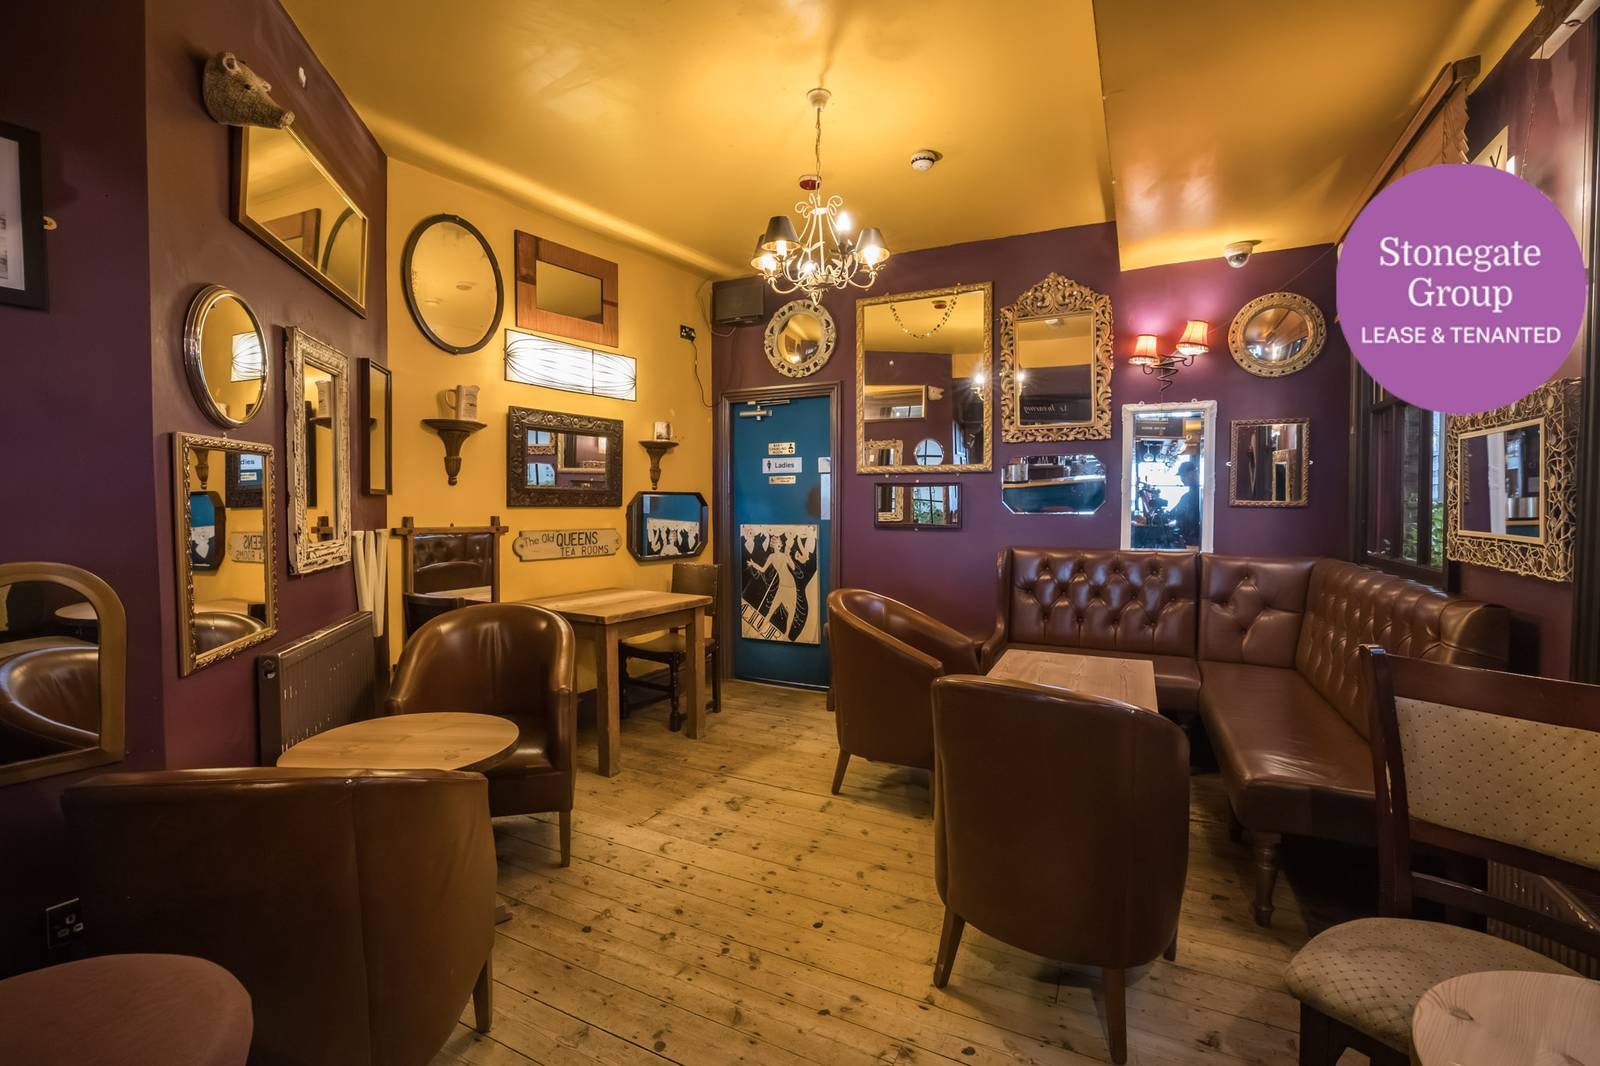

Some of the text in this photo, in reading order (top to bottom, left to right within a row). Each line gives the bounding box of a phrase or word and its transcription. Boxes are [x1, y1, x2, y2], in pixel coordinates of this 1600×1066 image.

[774, 461, 794, 469] Ladies
[524, 531, 598, 547] The Old QUEENS
[560, 544, 609, 557] TEA ROOMS
